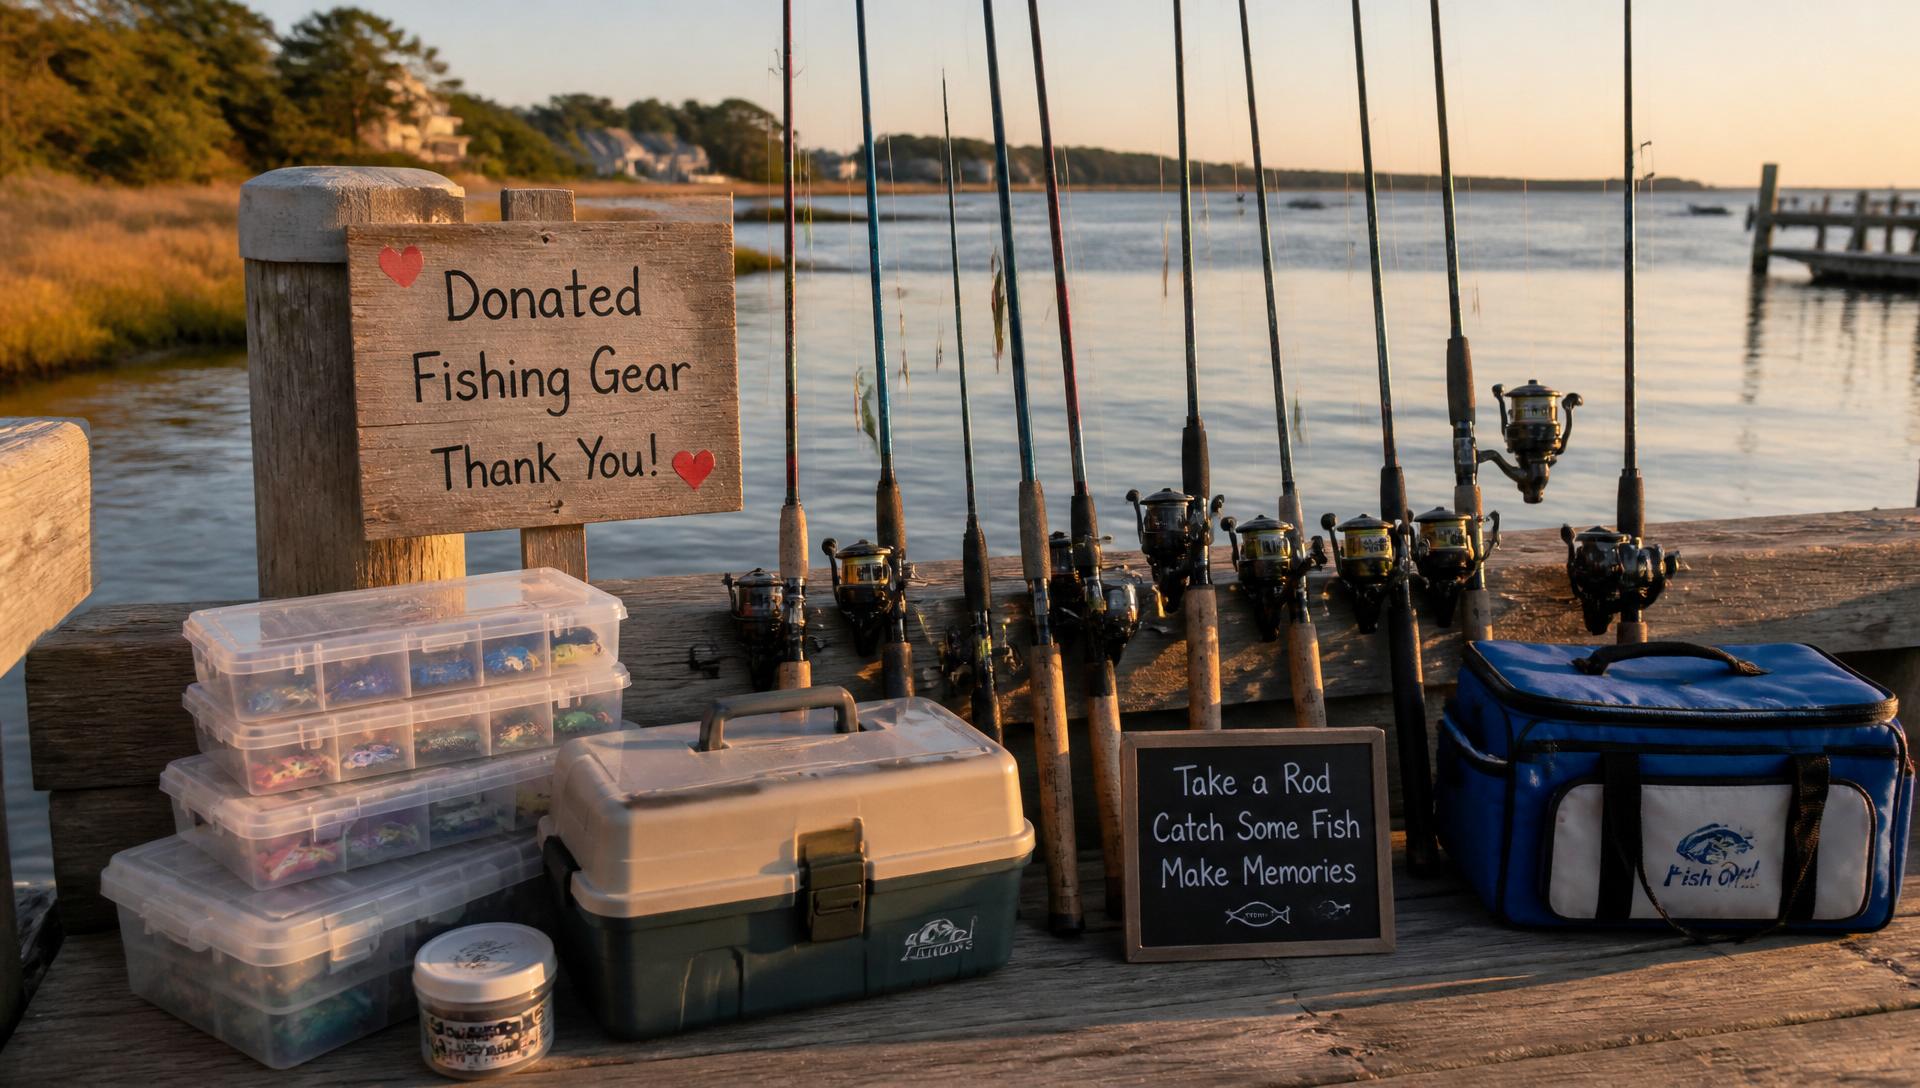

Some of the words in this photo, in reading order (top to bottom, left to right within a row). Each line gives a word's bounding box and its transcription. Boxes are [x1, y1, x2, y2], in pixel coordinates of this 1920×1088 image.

[445, 266, 641, 321] Donated
[413, 350, 570, 417] Fishing
[590, 345, 691, 394] Gear
[431, 442, 561, 491] Thank
[577, 433, 657, 480] You!
[1173, 764, 1238, 796] Take
[1252, 776, 1268, 794] a
[1283, 762, 1331, 794] Rod
[1153, 812, 1224, 843] Catch
[1237, 810, 1300, 841] Some
[1312, 808, 1360, 839] Fish
[1161, 857, 1229, 888] Make
[1243, 855, 1356, 886] Memories
[1663, 864, 1712, 887] Fish
